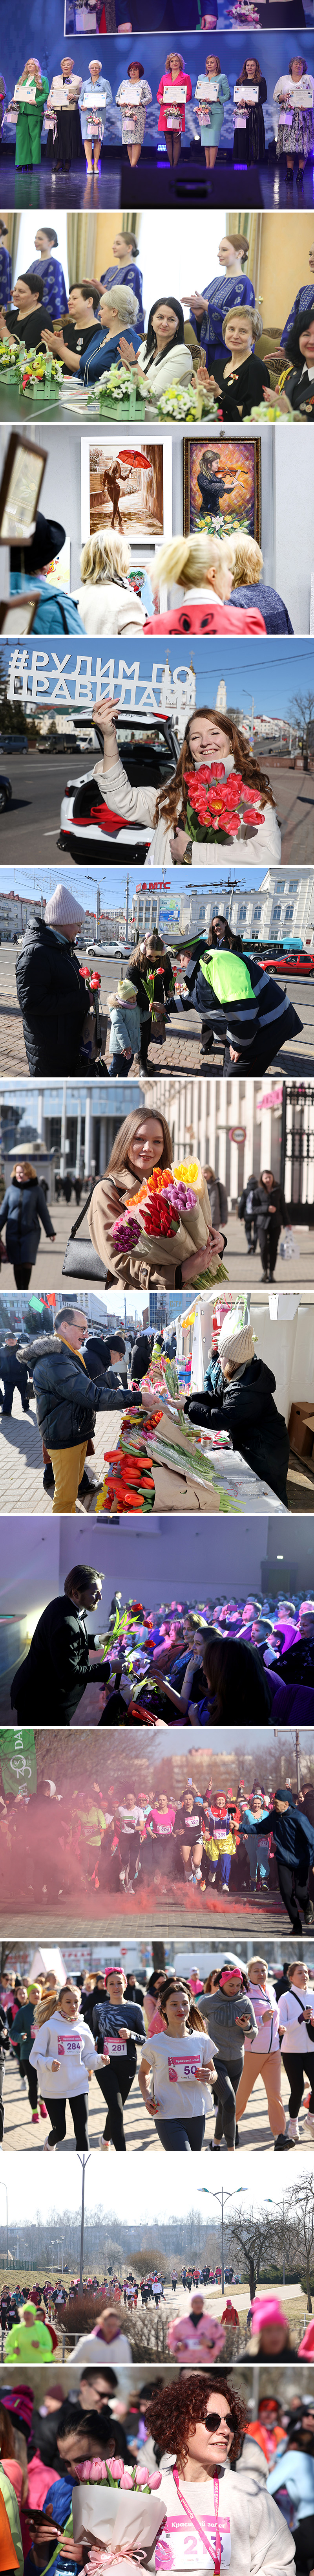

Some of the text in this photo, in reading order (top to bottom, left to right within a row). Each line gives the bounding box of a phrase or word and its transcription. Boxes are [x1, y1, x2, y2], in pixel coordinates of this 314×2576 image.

[9, 650, 194, 686] #РУЛИМ ПО
[9, 673, 192, 711] ПРАВИЛАМ!
[184, 2065, 197, 2075] 50
[181, 2498, 194, 2519] Красивый
